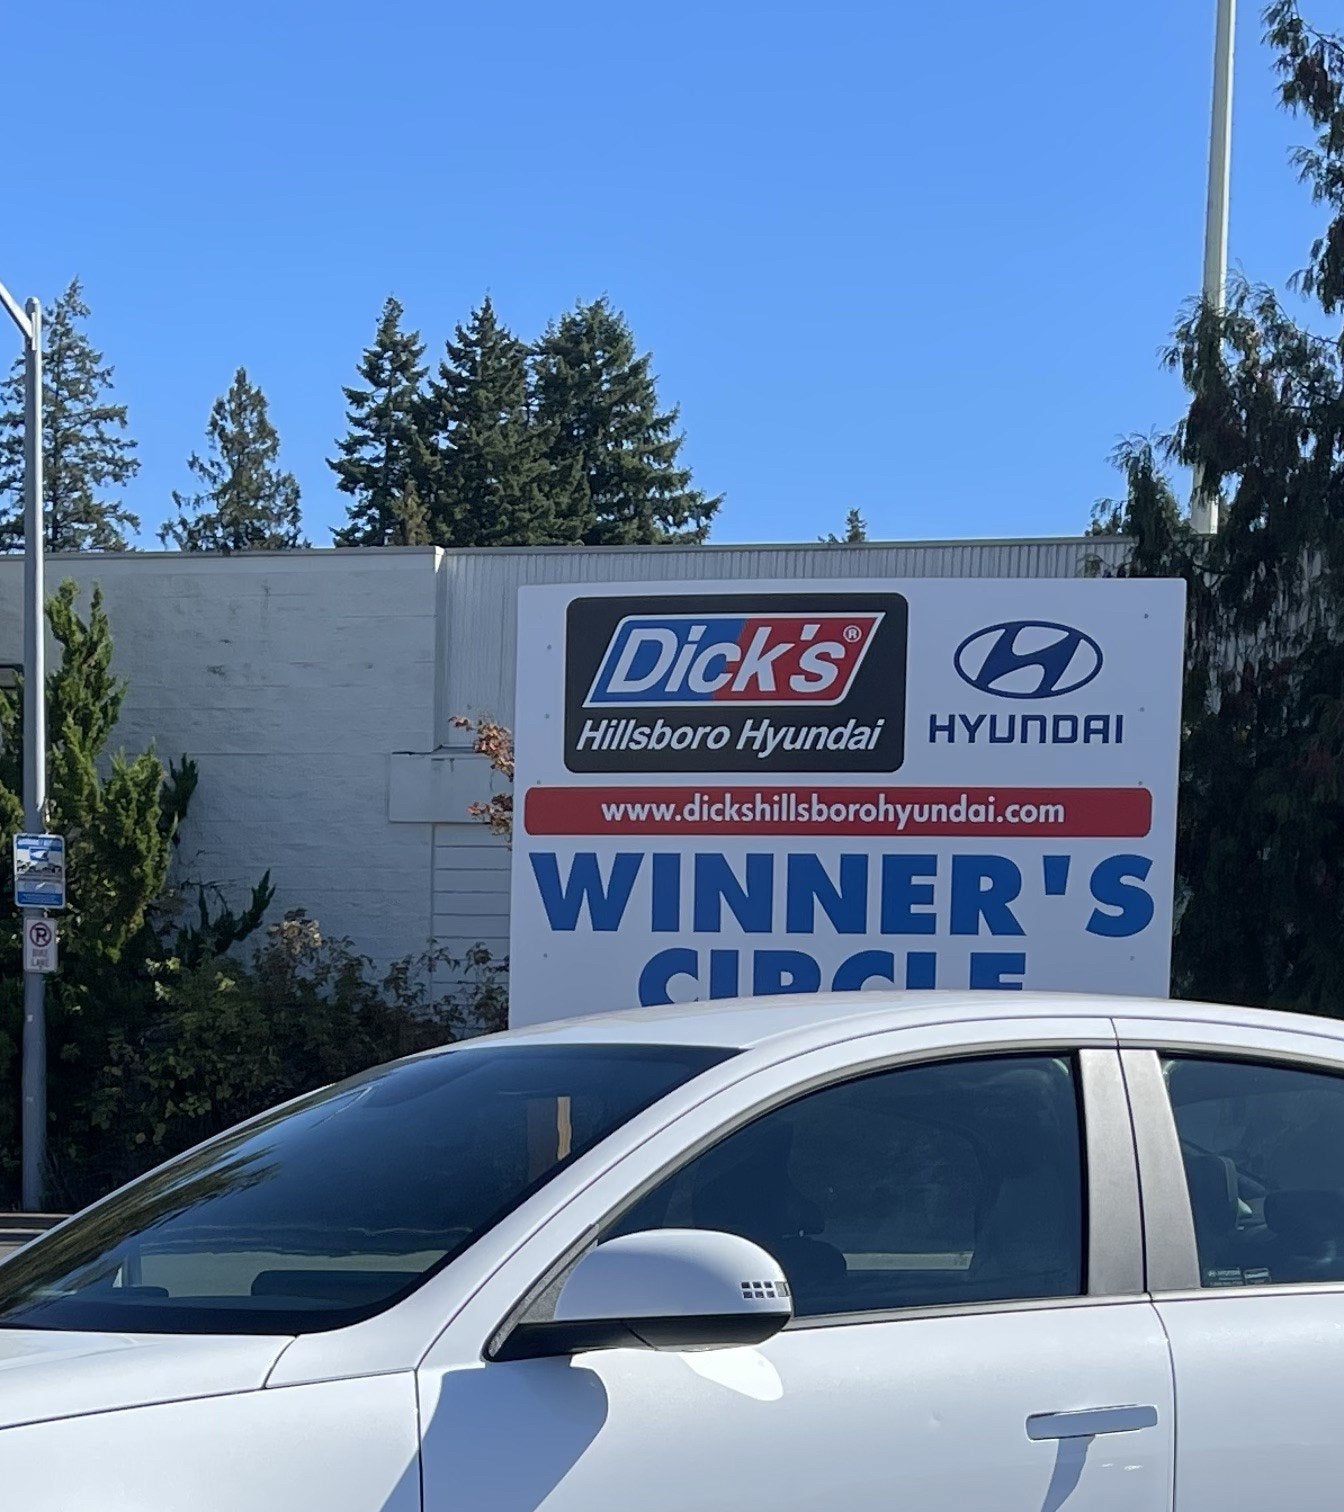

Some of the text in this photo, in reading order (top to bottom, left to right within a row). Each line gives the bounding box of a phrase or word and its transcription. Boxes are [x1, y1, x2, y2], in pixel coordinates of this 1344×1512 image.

[575, 718, 886, 759] Hillsboro Hyundai
[928, 713, 1124, 744] HYUNDAI
[600, 793, 1066, 830] www.dickshillsborohyundai.com
[528, 852, 1156, 938] WINNER'S
